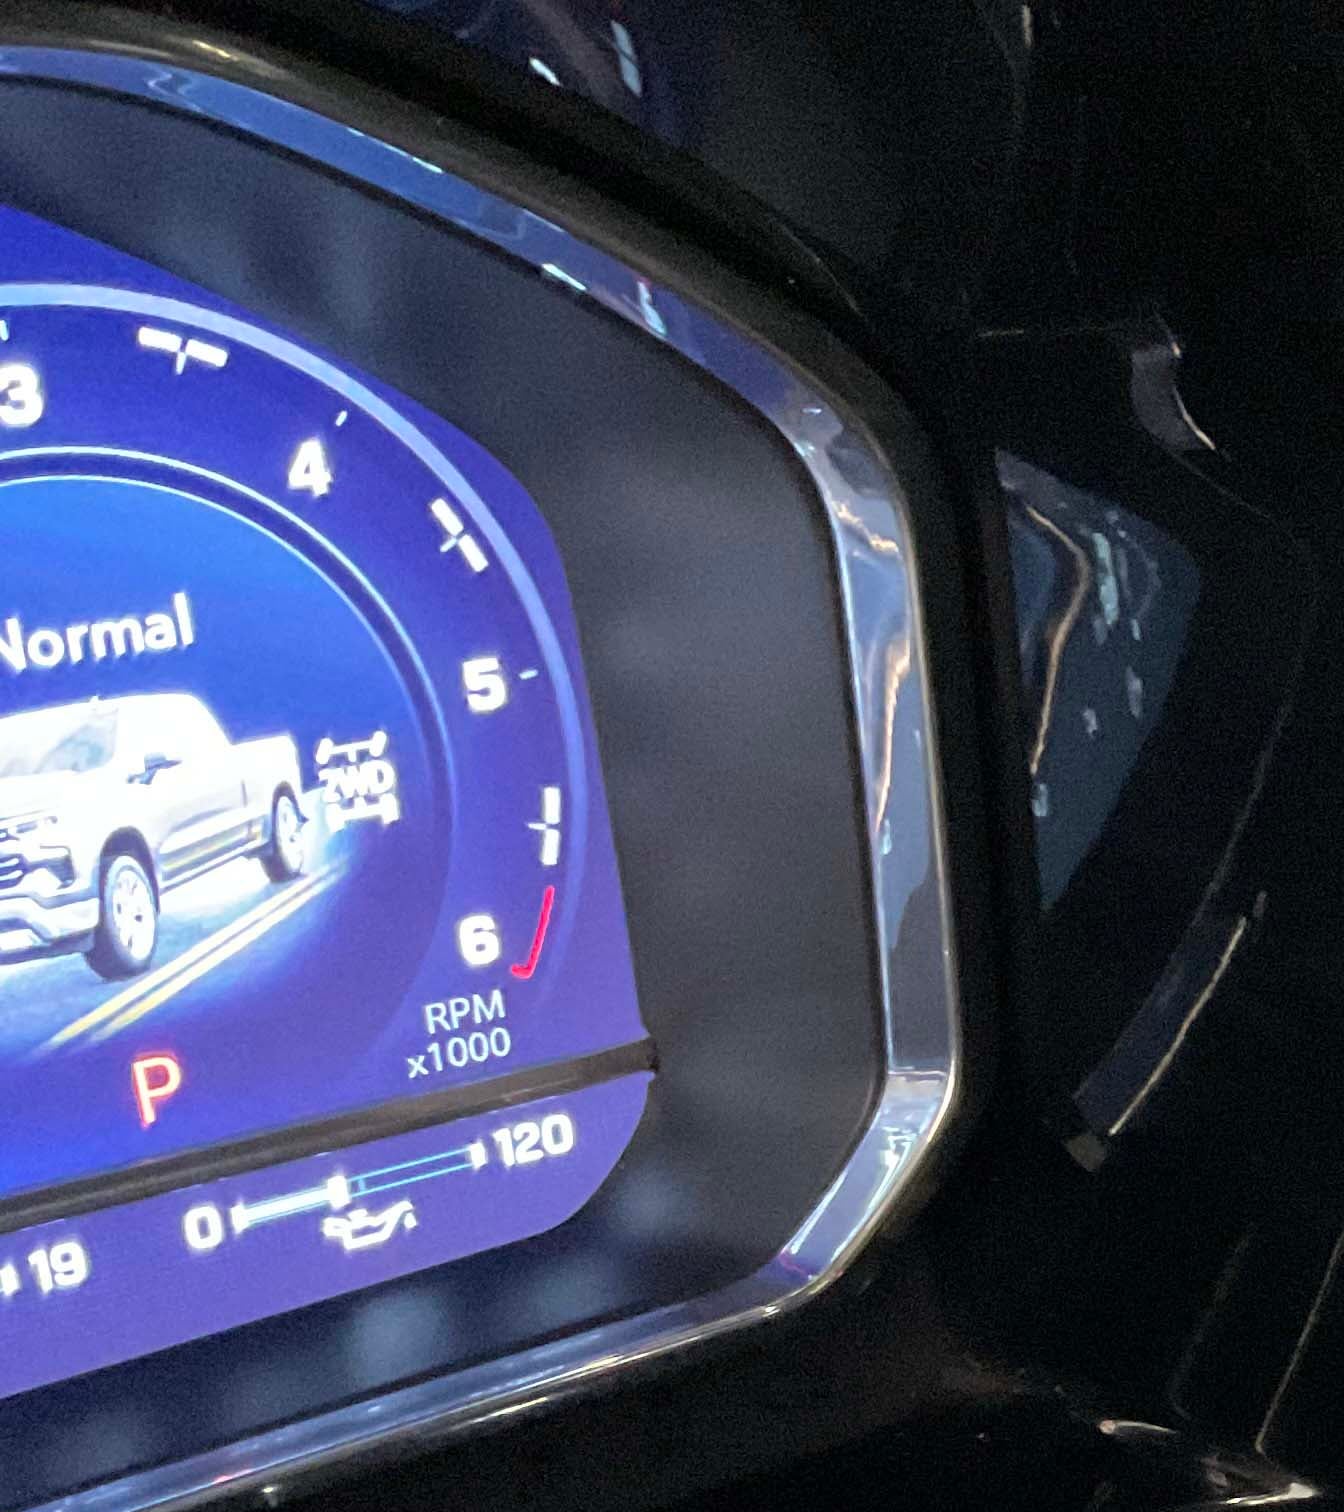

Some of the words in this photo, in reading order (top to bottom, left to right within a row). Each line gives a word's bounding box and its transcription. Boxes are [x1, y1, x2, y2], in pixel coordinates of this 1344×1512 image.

[0, 364, 43, 427] 3
[288, 438, 333, 497] 4
[462, 657, 507, 712] 5
[319, 760, 395, 803] 2WD
[458, 914, 501, 966] 6
[425, 989, 506, 1035] RPM
[407, 1027, 511, 1079] x1000
[132, 1054, 181, 1127] P
[493, 1113, 573, 1168] 120
[185, 1206, 223, 1250] 0
[28, 1242, 86, 1293] 19
